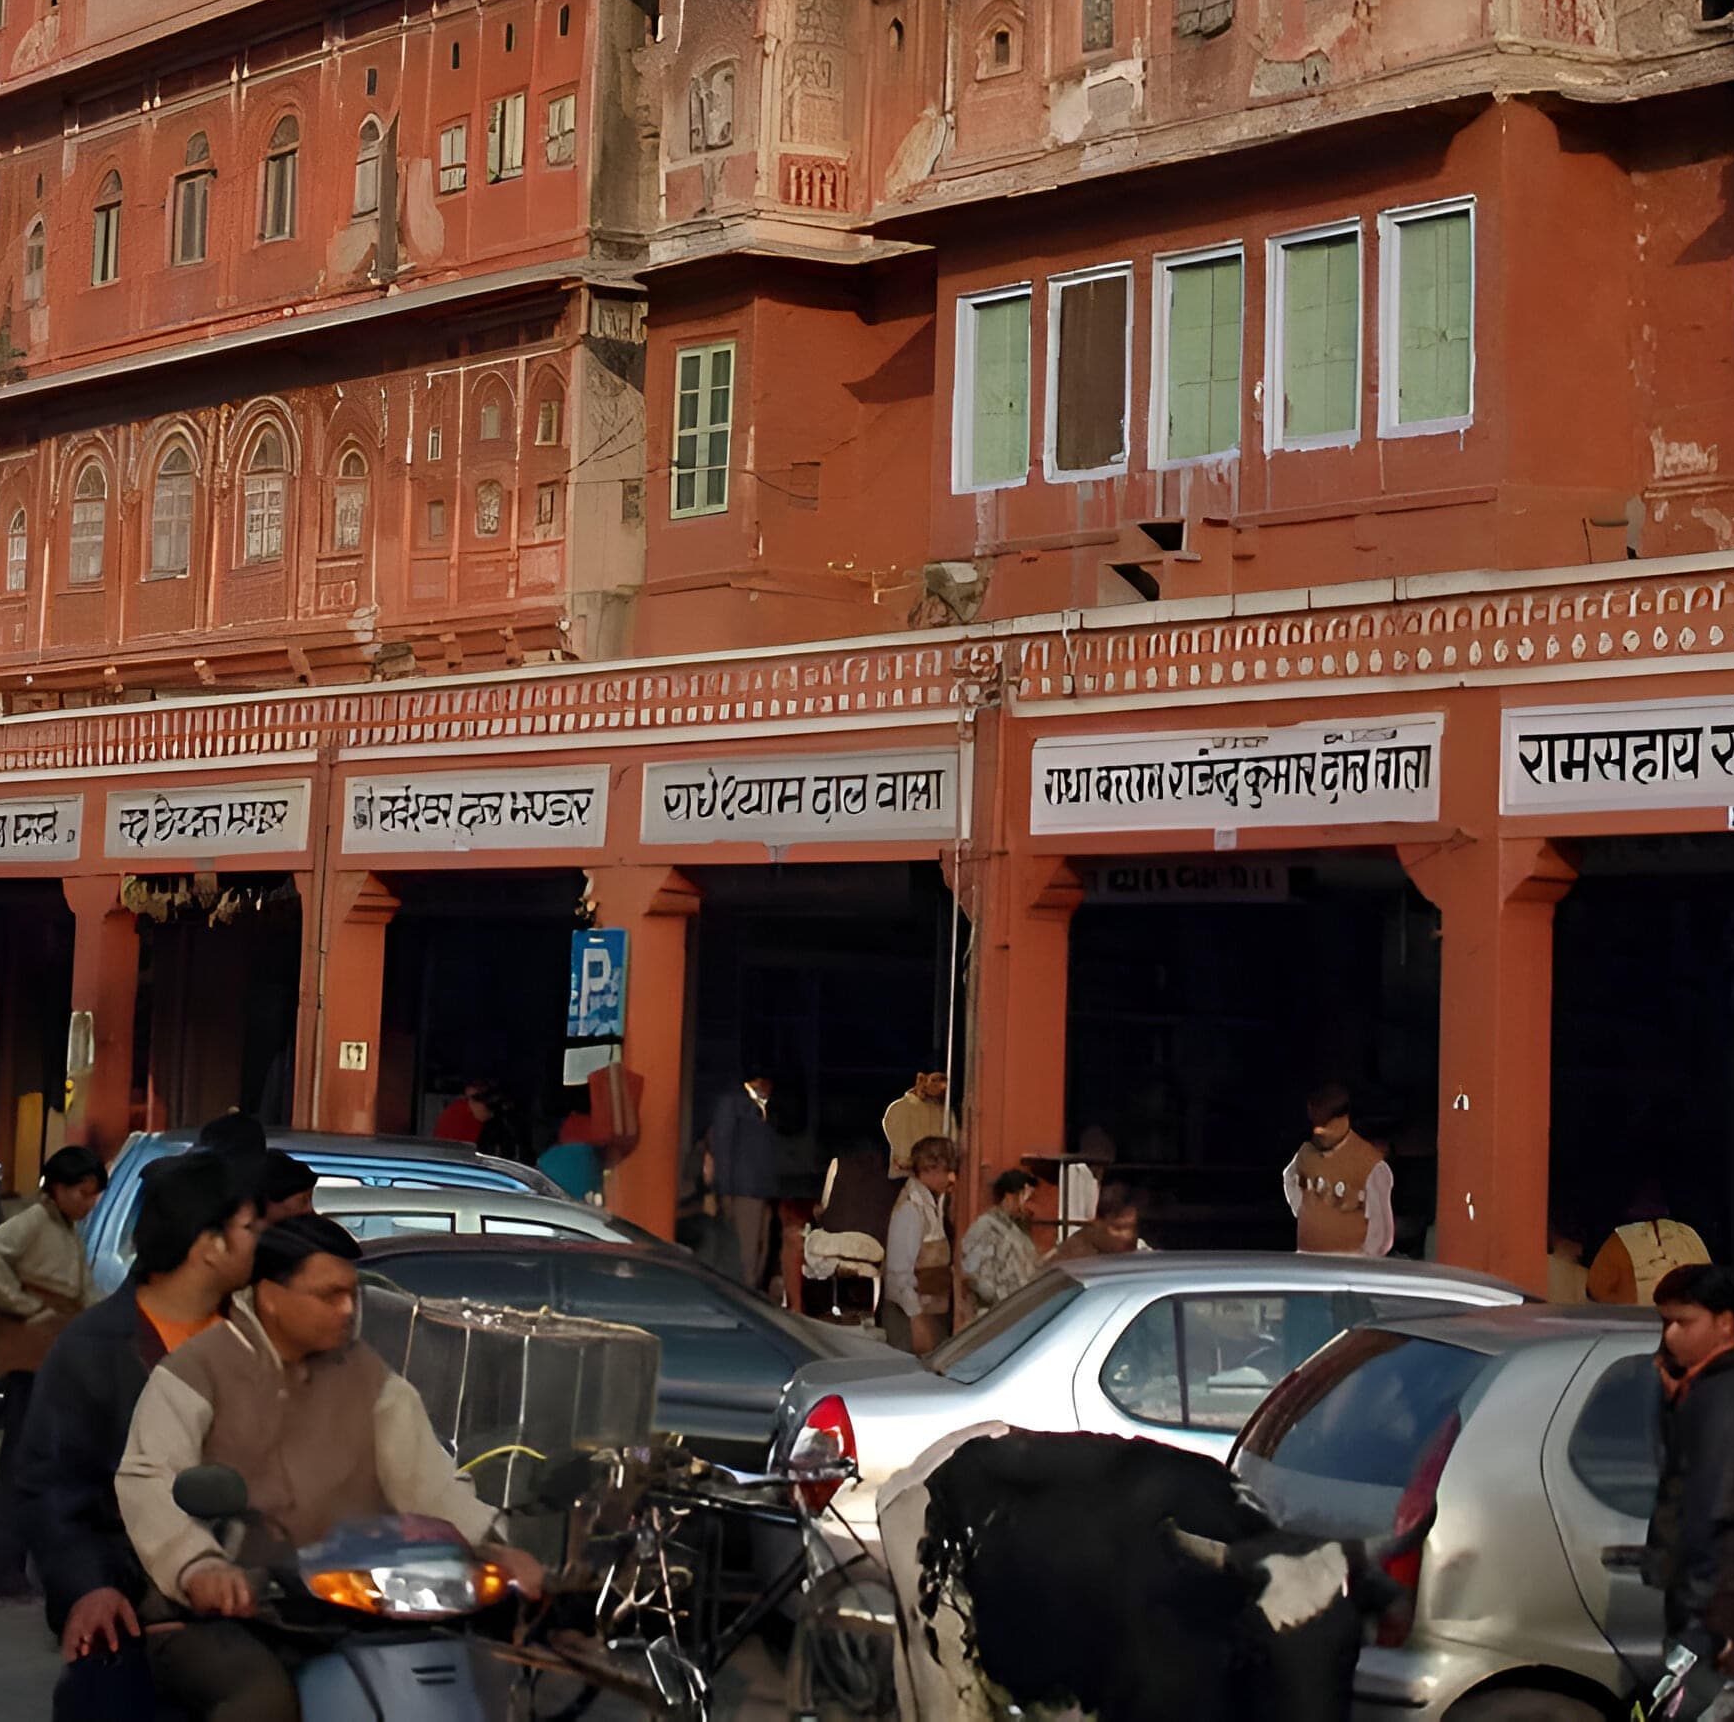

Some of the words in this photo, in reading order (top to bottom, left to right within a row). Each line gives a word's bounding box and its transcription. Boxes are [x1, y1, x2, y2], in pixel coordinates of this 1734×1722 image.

[1242, 753, 1316, 808] कुमार
[1519, 727, 1703, 784] रामसहाय
[579, 948, 611, 1035] P
